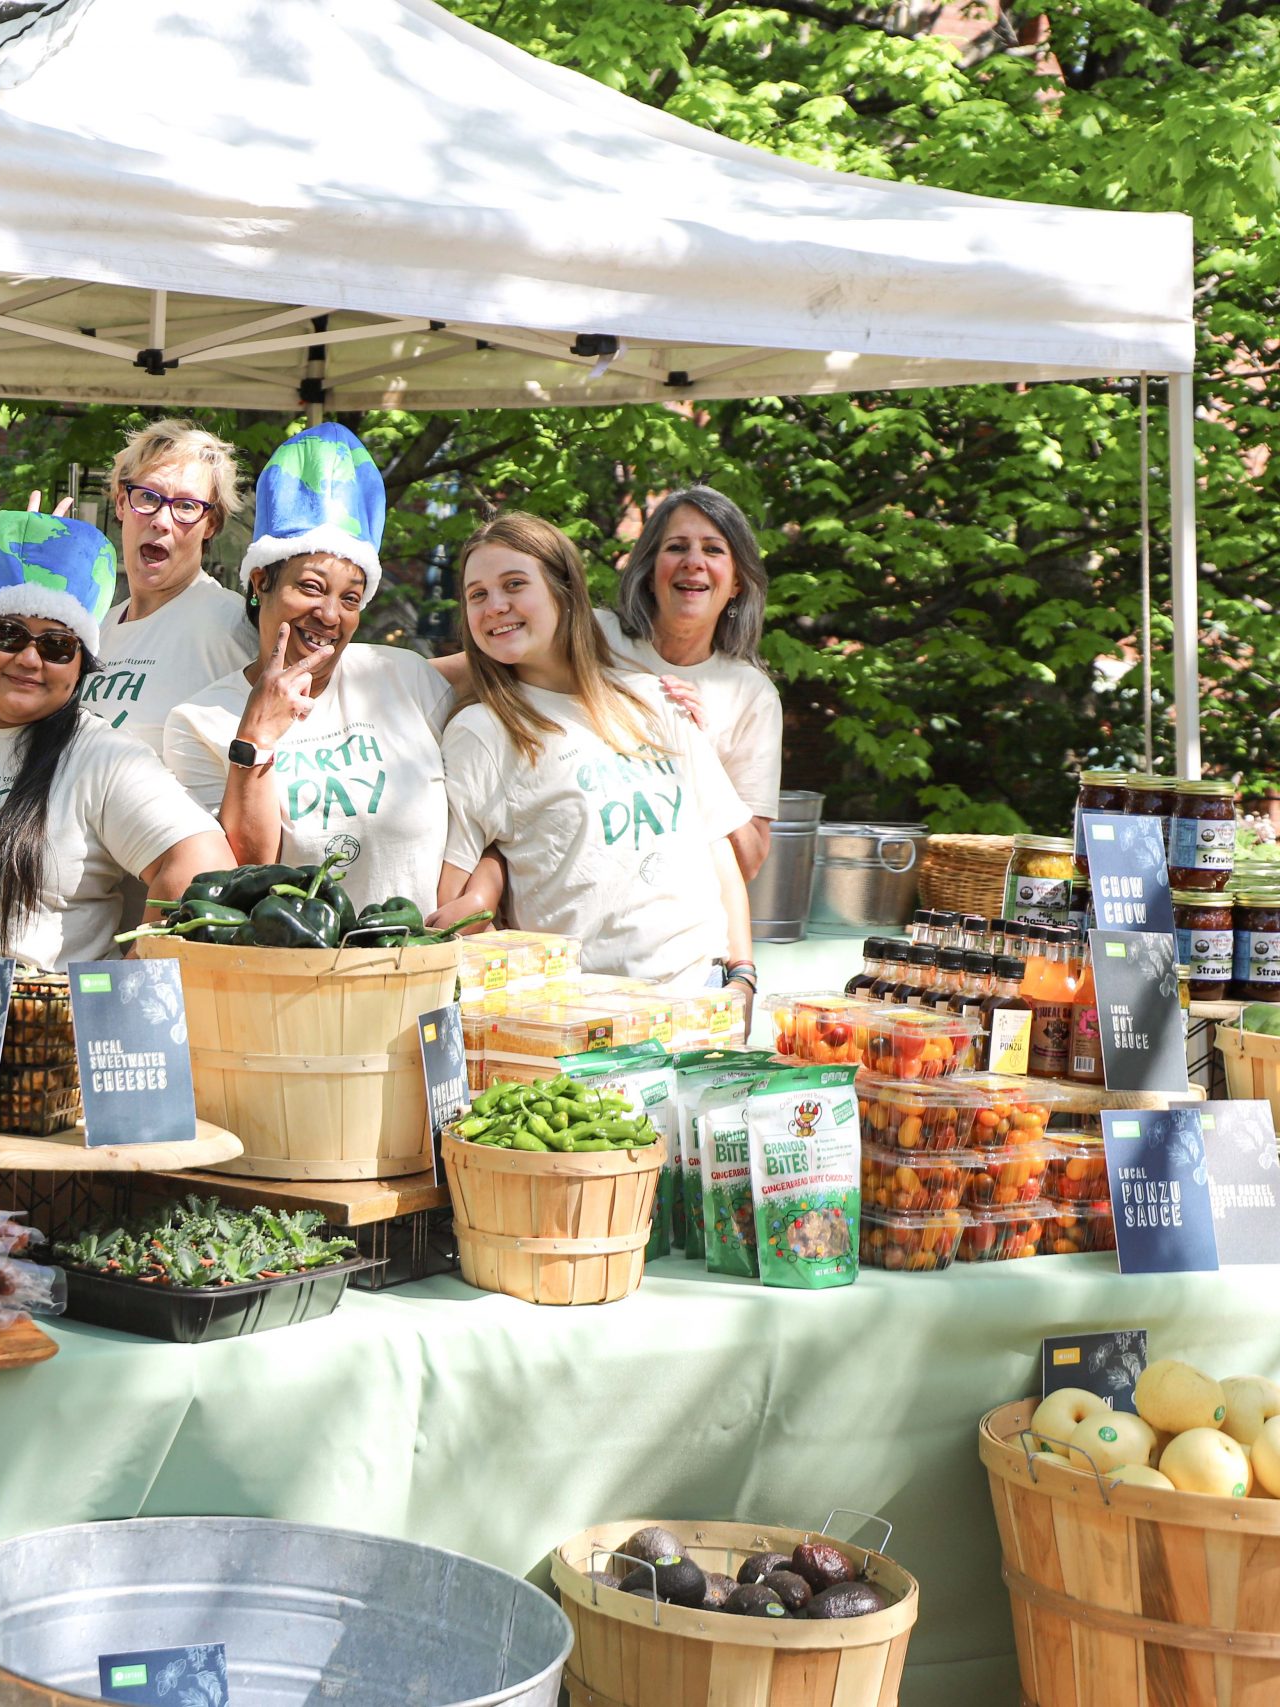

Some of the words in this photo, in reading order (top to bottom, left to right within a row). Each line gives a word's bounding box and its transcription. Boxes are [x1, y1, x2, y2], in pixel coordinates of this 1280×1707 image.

[287, 770, 386, 829] DAY
[599, 785, 682, 851] DAY
[1100, 875, 1144, 898] CHOW
[1103, 901, 1147, 924] CHOW
[1110, 1004, 1130, 1015] LOCAL
[1112, 1015, 1133, 1033] HOT
[88, 1039, 124, 1055] LOCAL
[1000, 1042, 1022, 1052] PONZU
[1114, 1032, 1150, 1050] SAUCE
[89, 1052, 167, 1070] SWEETWATER
[92, 1067, 168, 1093] CHEESES
[763, 1139, 807, 1155] GRANOLA
[1118, 1167, 1147, 1180] LOCAL
[1121, 1180, 1181, 1204] PONZU
[1124, 1203, 1183, 1227] SAUCE
